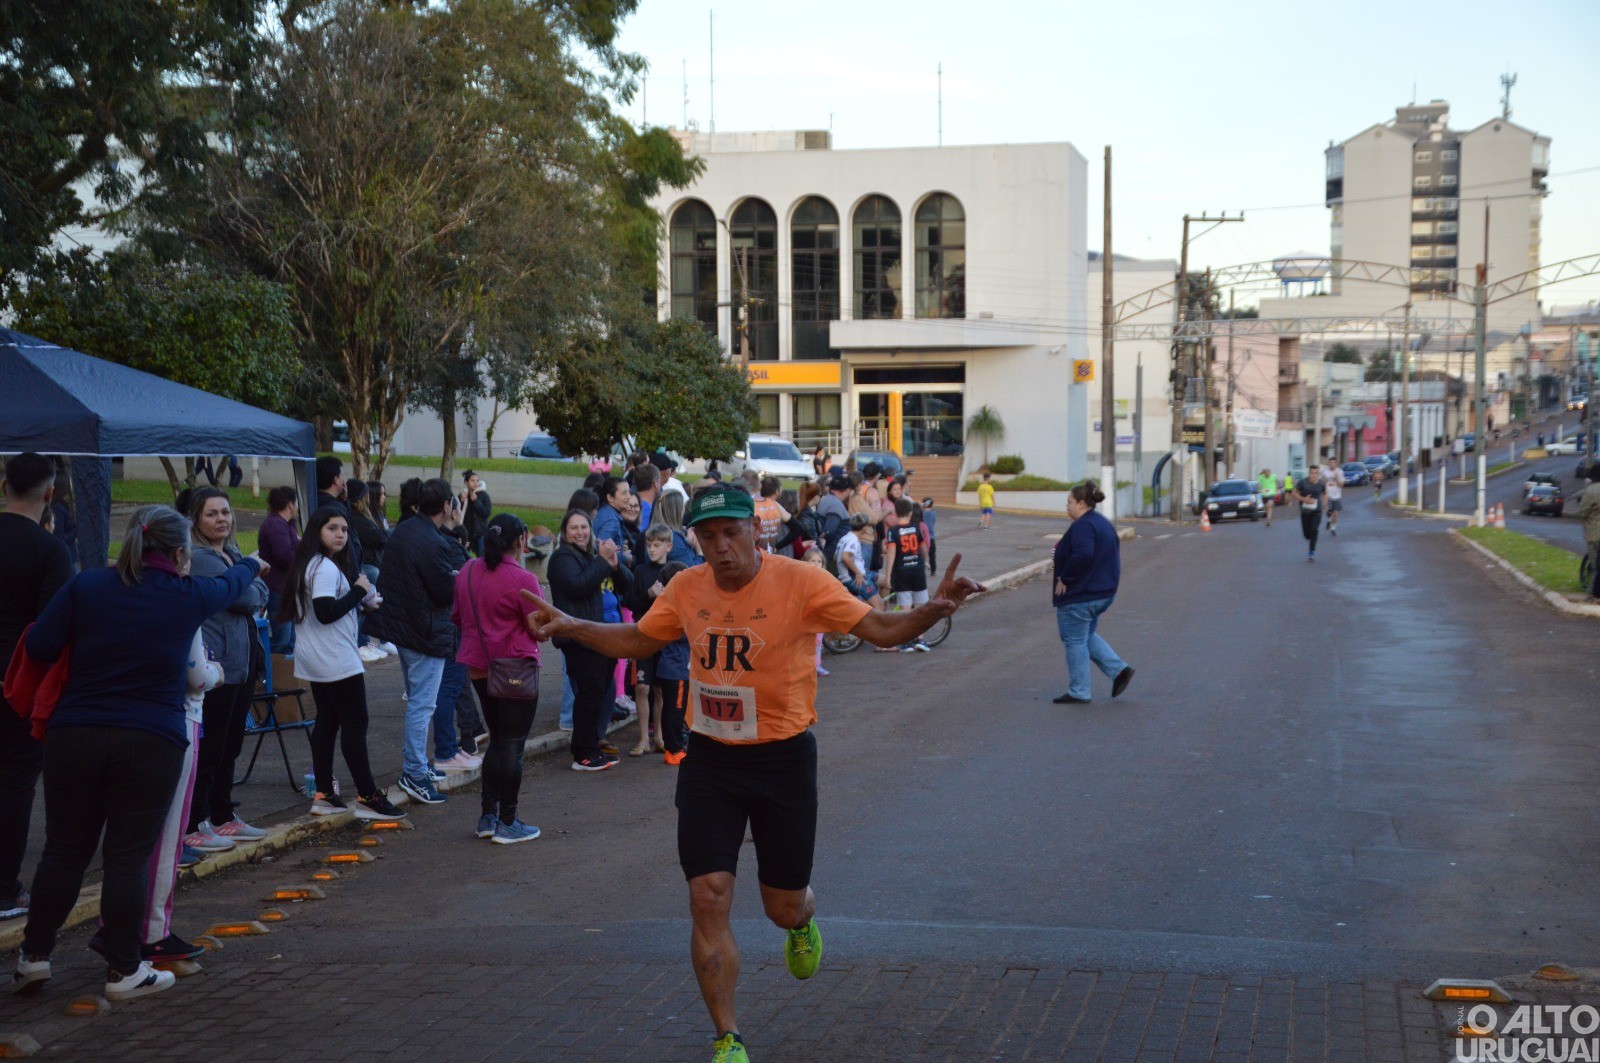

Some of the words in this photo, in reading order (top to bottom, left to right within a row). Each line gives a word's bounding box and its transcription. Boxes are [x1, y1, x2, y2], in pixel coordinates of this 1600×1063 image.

[746, 369, 770, 380] ASIL
[700, 497, 725, 508] UNIMED
[700, 633, 755, 672] JR
[705, 698, 739, 718] 117
